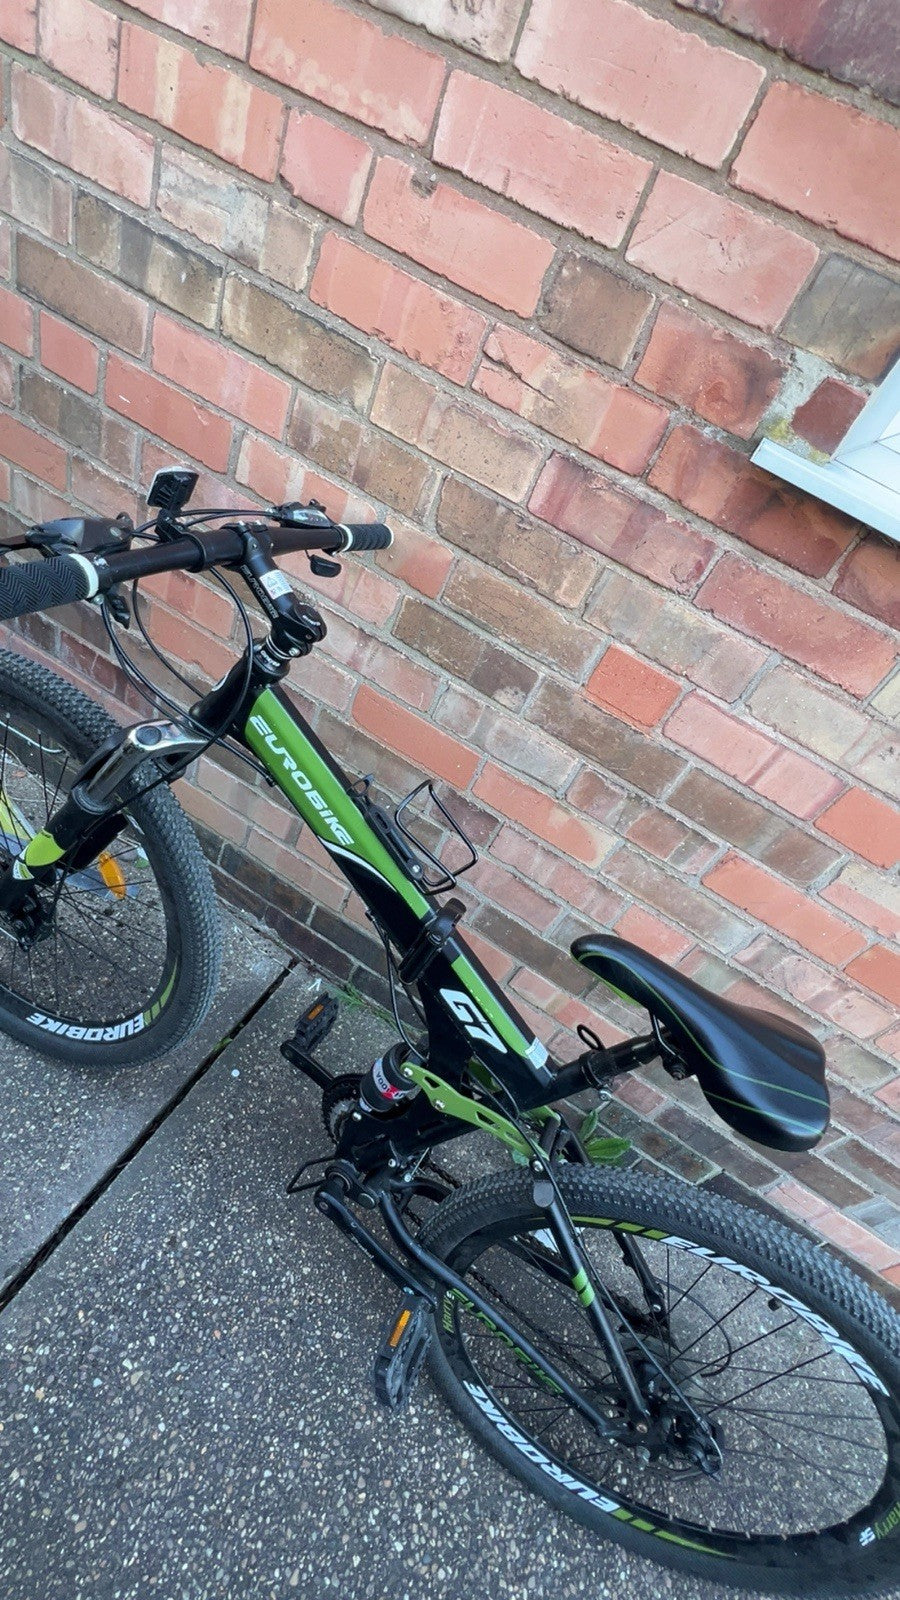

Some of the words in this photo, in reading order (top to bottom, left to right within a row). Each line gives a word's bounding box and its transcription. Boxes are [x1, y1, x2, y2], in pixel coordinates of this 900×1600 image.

[250, 715, 355, 846] EUROBIKE
[25, 1012, 145, 1041] EUROBIKE
[440, 988, 508, 1054] G7
[660, 1236, 891, 1397] EUROBIKE
[463, 1380, 620, 1513] EUROBIKE
